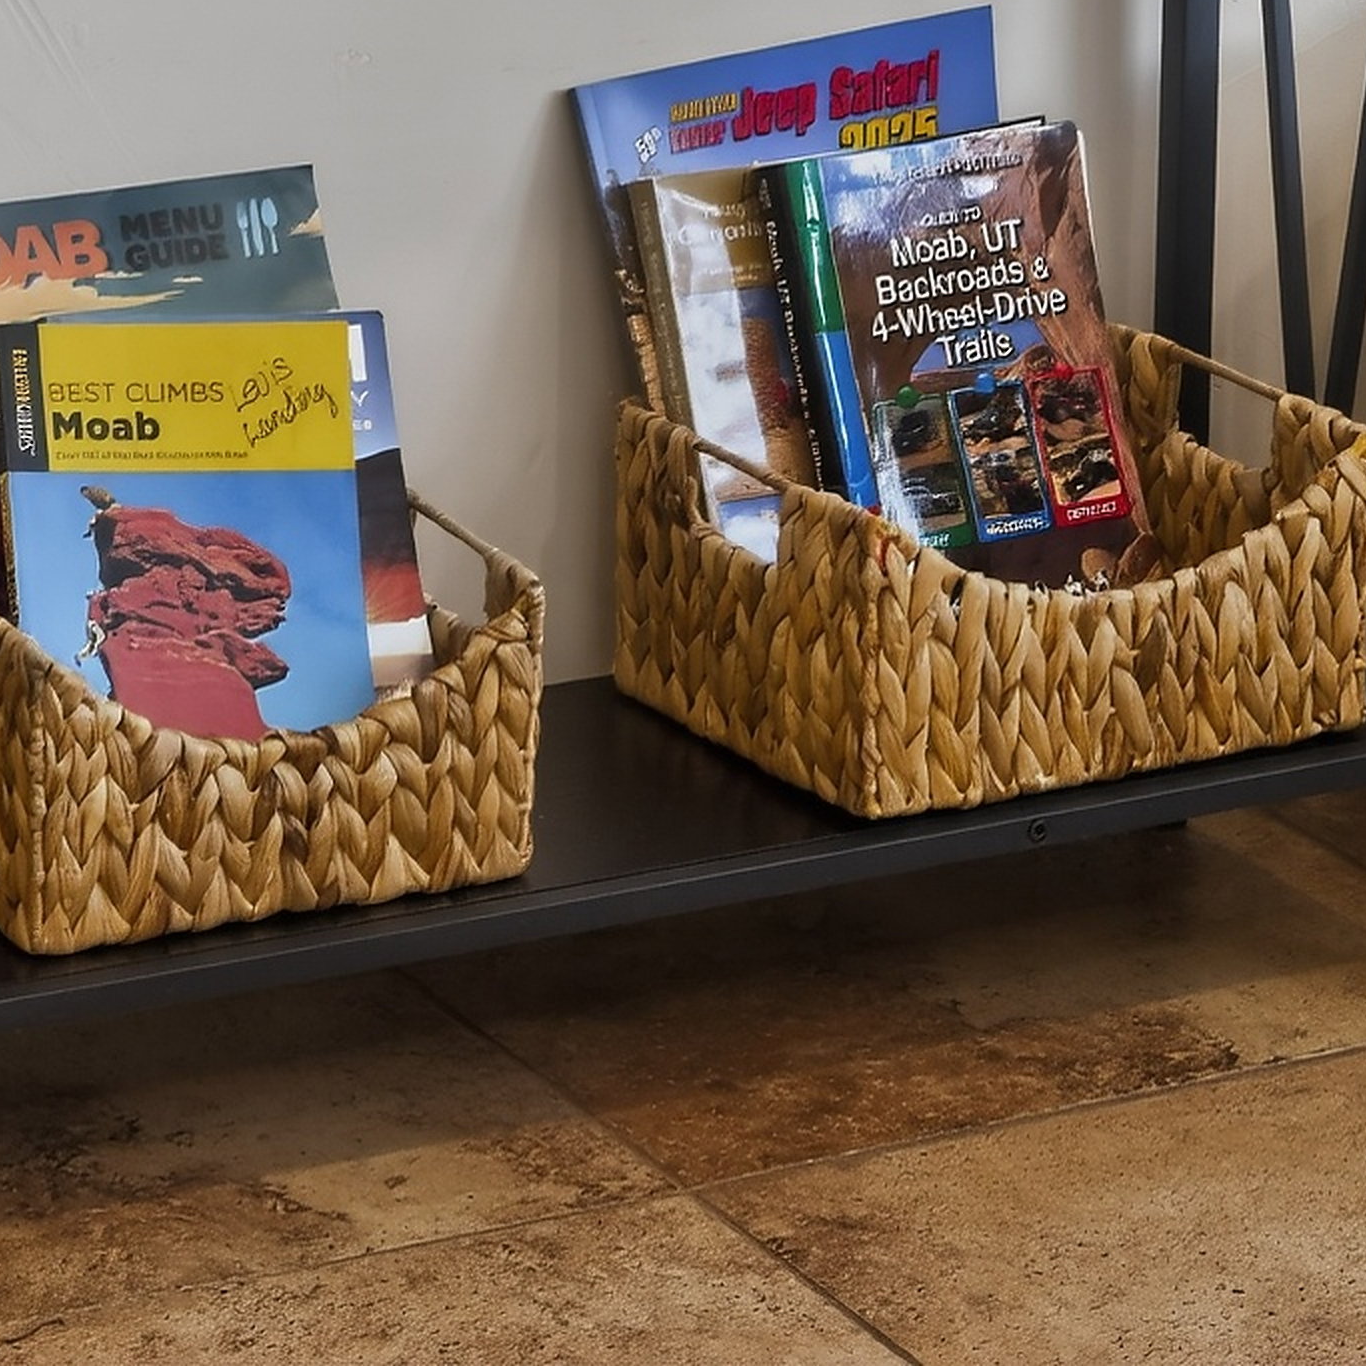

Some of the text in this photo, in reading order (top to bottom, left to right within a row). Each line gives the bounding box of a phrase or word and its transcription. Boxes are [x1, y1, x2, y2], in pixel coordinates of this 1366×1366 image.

[732, 82, 818, 142] Jeep
[829, 49, 940, 120] Safari
[839, 106, 939, 148] 2025
[119, 203, 223, 241] MENU
[124, 238, 230, 273] GUIDE
[890, 219, 1022, 267] Moab, UT
[875, 256, 1050, 305] Backroads &
[872, 287, 1067, 343] 4-Wheel-Drive
[935, 329, 1013, 367] Trails
[48, 383, 224, 403] BEST CLIMBS
[52, 411, 160, 441] Moab
